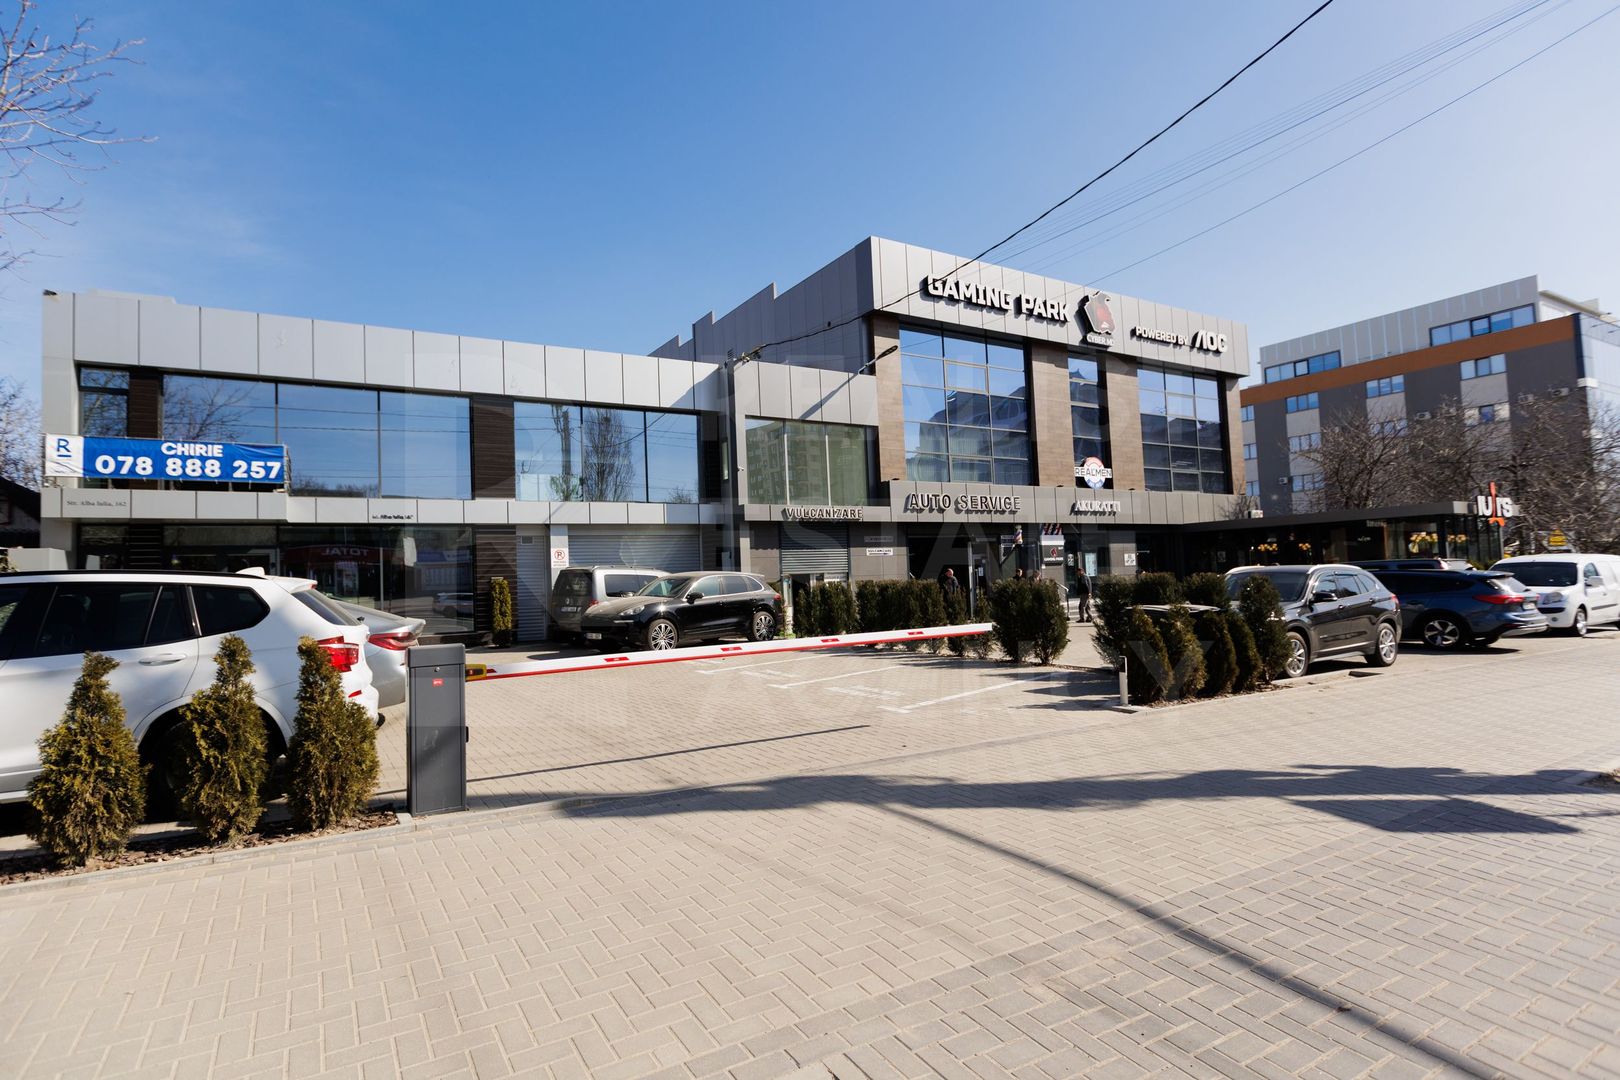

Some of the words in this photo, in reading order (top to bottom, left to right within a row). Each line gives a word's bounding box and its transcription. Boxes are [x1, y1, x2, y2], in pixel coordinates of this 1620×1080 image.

[927, 273, 1014, 310] GAMING
[1020, 293, 1072, 321] PARK
[1135, 326, 1177, 343] POWERED
[1178, 335, 1189, 346] BY
[57, 438, 71, 453] R
[161, 442, 224, 458] CHIRIE
[95, 455, 153, 476] 078
[165, 458, 221, 478] 888
[232, 460, 281, 479] 257
[909, 493, 952, 511] AUTO
[959, 494, 1021, 512] SERVICE
[786, 506, 864, 519] VULCANIZARE
